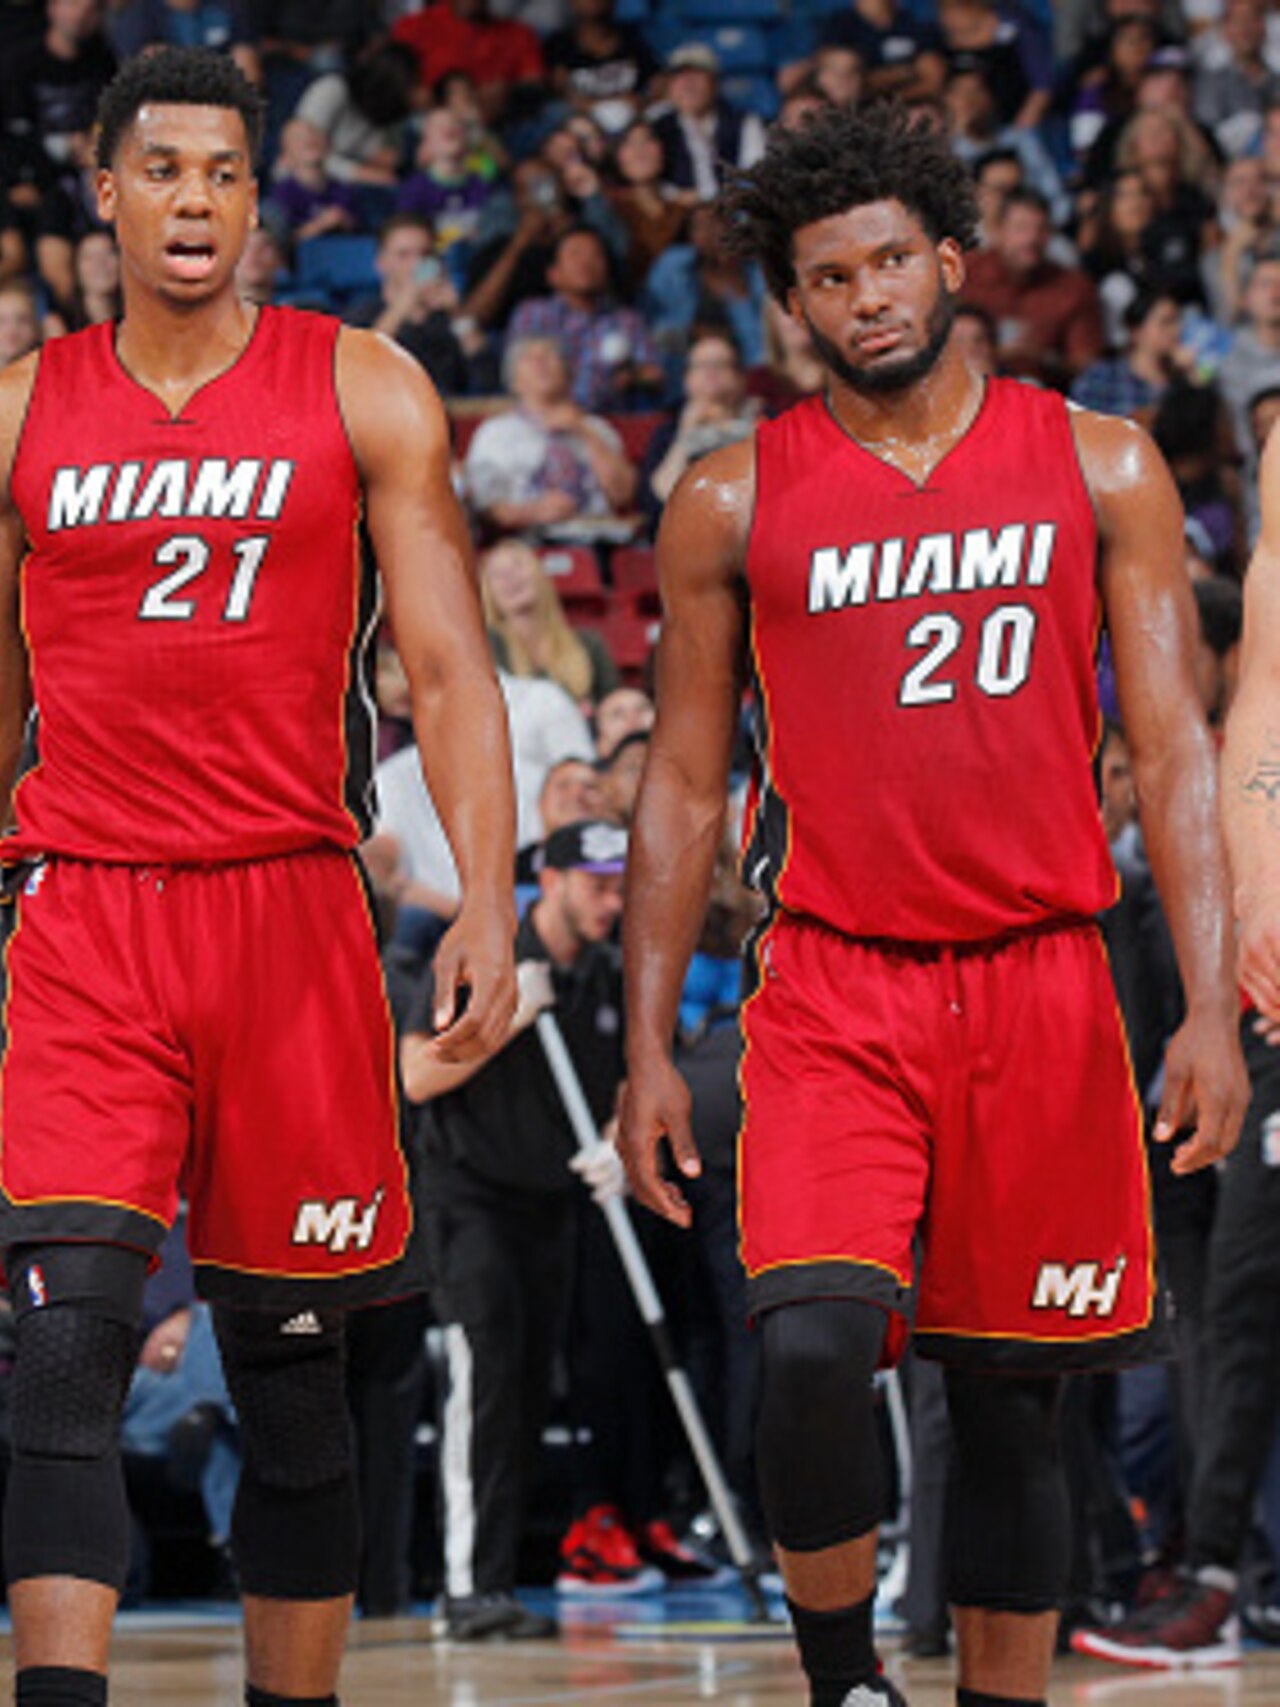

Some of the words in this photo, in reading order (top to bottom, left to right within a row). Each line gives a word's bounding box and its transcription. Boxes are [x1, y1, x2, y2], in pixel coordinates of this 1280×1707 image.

[46, 457, 296, 532] MIAMI
[137, 534, 271, 621] 21
[807, 521, 1057, 616] MIAMI
[897, 603, 1037, 707] 20
